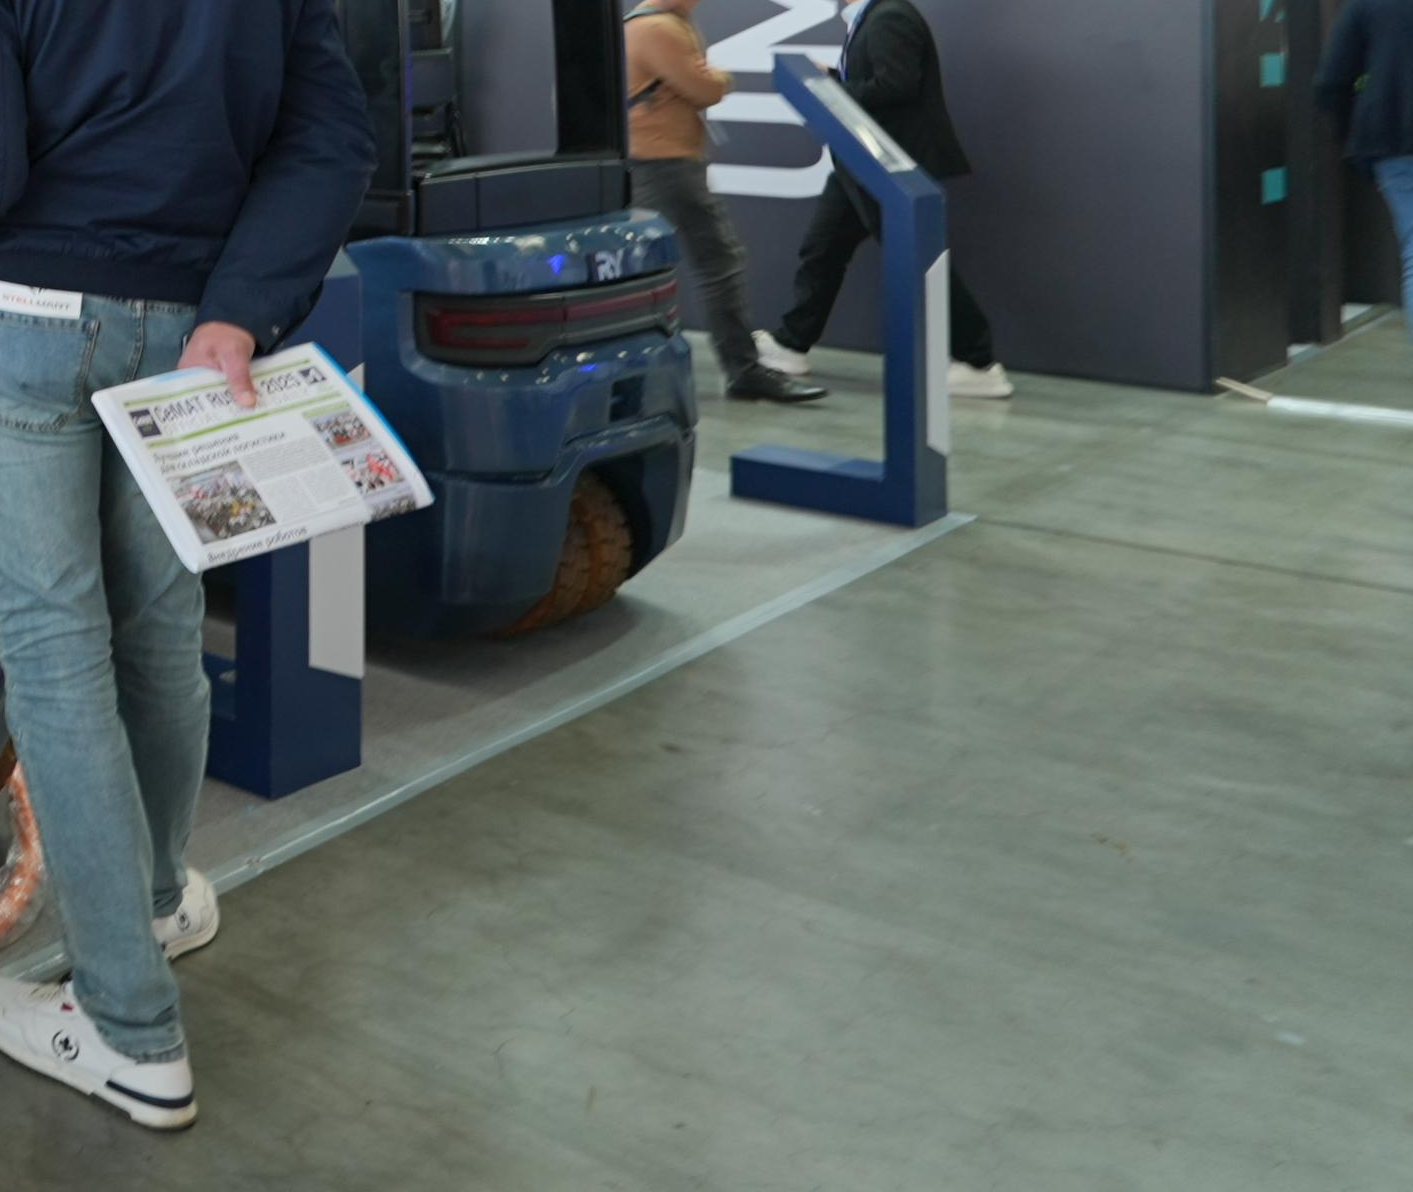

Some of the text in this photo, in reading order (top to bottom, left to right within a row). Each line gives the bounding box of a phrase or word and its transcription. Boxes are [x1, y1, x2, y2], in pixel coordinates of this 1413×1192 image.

[595, 247, 624, 281] RY
[153, 395, 204, 423] CeMAT
[260, 372, 301, 395] 2025
